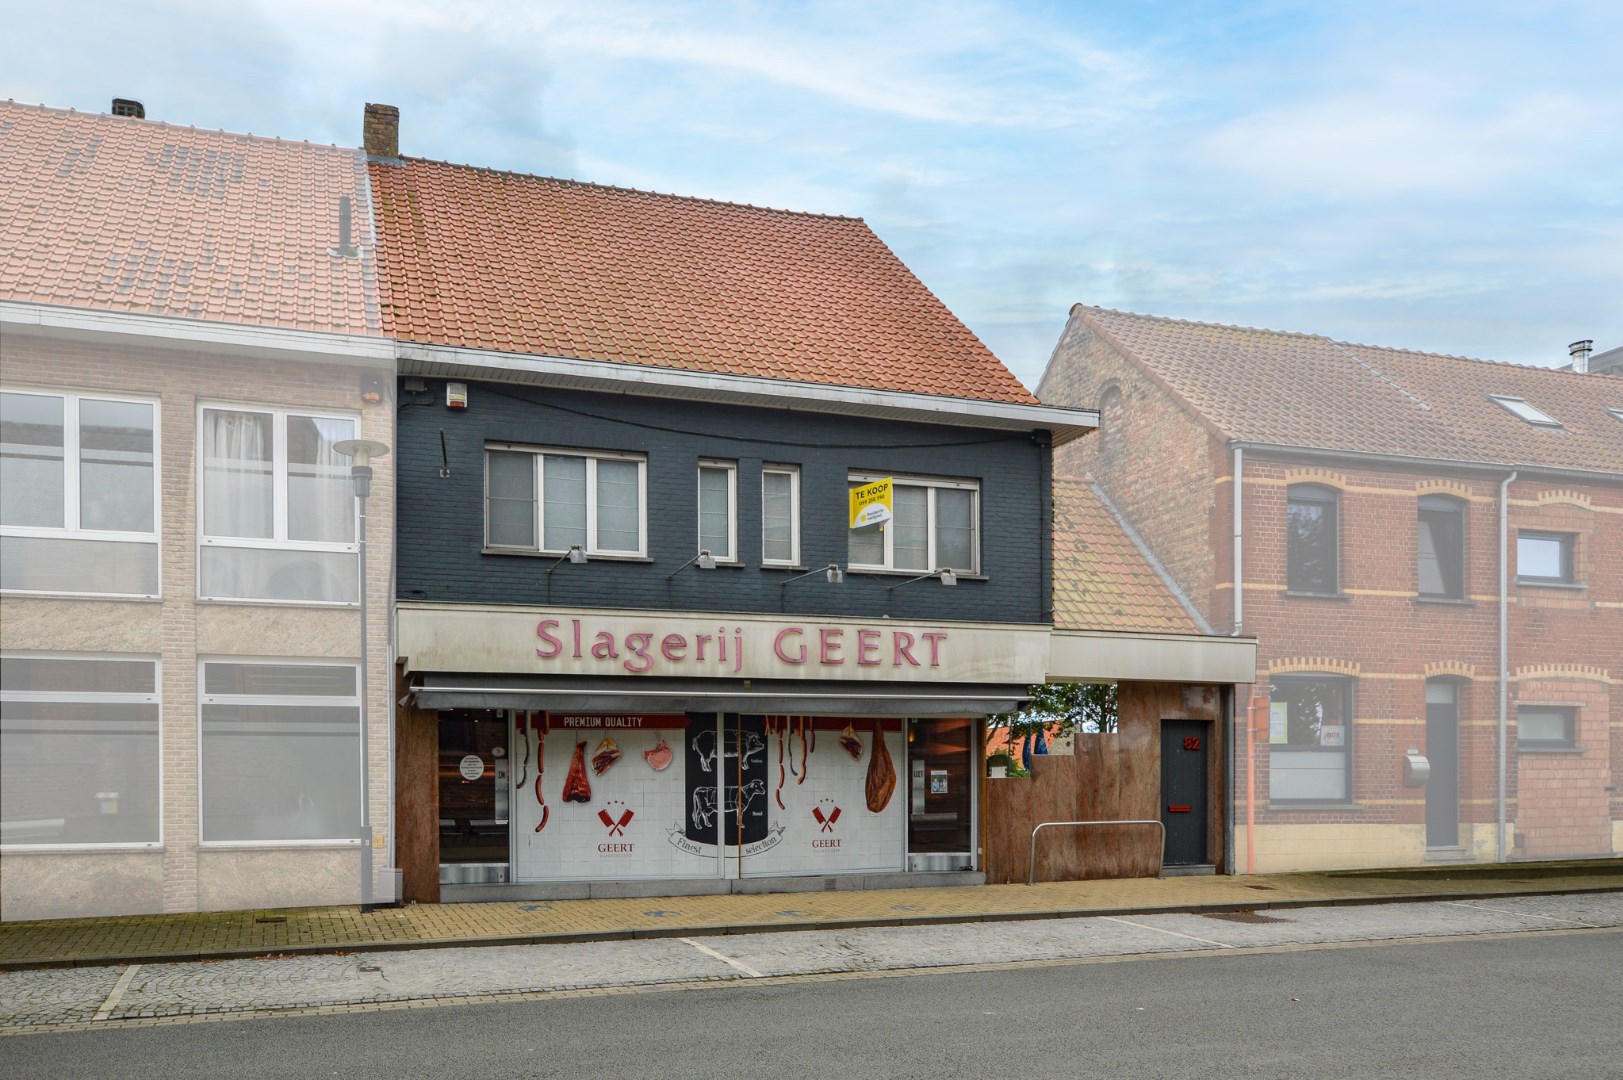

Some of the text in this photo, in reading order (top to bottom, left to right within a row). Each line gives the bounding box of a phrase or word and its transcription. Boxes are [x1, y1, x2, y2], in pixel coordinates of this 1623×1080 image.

[856, 484, 888, 499] TE KOOP
[536, 619, 948, 673] Slagerij GEERT
[564, 716, 643, 727] PREMIUM QUALITY
[1184, 736, 1200, 750] 82
[498, 770, 506, 779] IN
[913, 770, 924, 778] UIT
[597, 843, 635, 853] GEERT
[677, 836, 777, 854] Finest selection
[811, 839, 842, 848] GEERT
